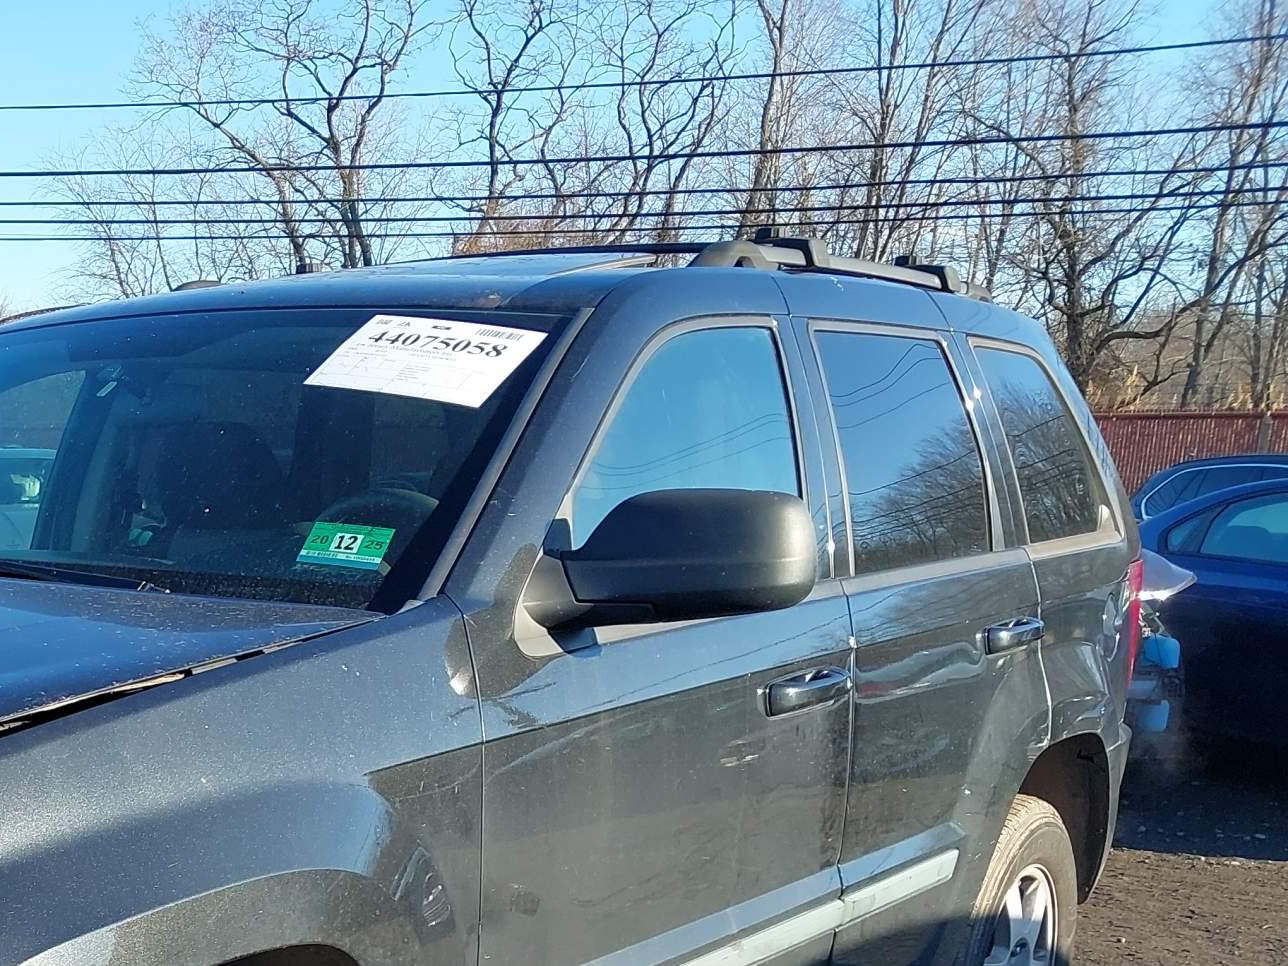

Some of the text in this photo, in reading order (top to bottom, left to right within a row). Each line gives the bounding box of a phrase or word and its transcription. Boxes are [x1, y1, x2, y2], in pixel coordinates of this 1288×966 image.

[368, 330, 508, 358] 44075058
[311, 533, 385, 551] 20 12 25
